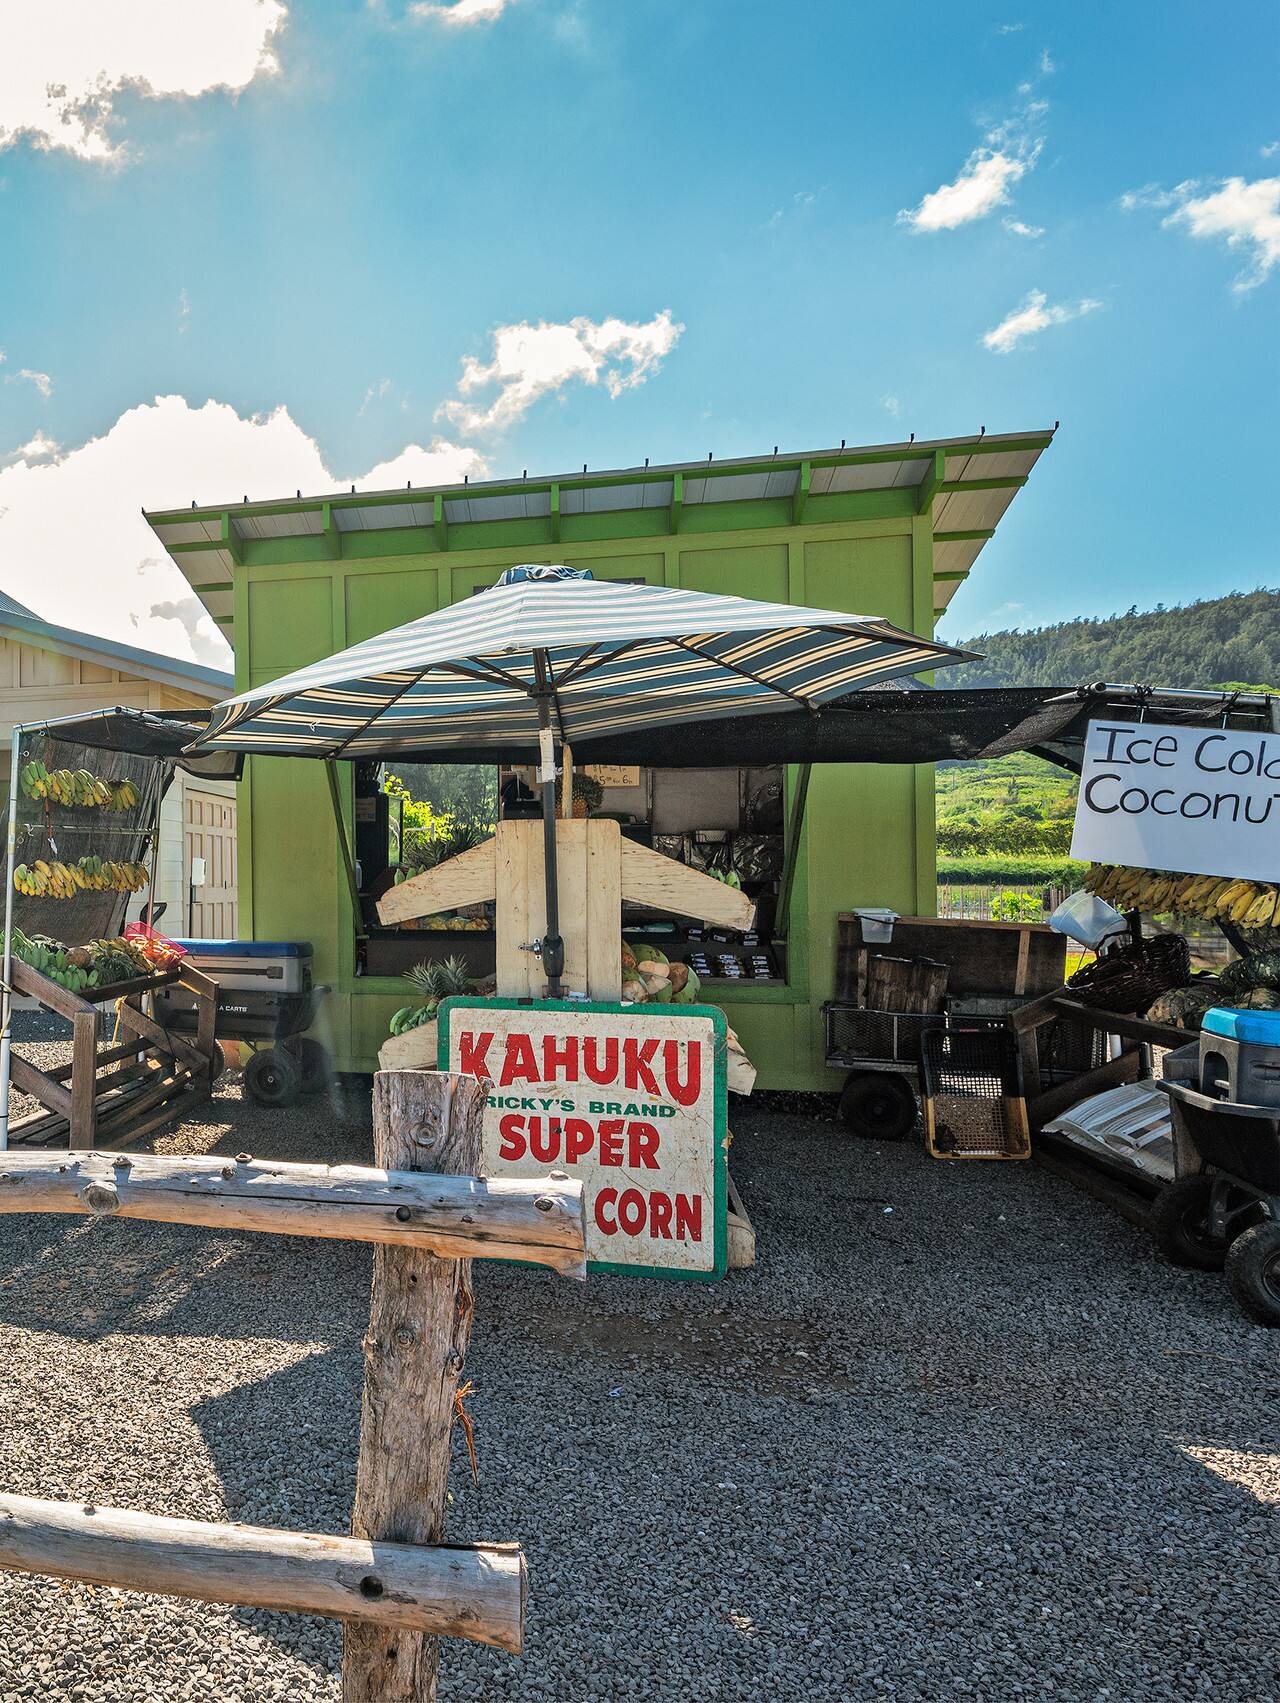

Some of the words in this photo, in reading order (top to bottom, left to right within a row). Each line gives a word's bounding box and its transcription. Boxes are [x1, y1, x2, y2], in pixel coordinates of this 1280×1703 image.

[1093, 726, 1179, 768] Ice
[1084, 773, 1280, 825] Coconu
[458, 1031, 702, 1107] KAHUKU
[589, 1101, 677, 1118] BRAND
[498, 1113, 661, 1170] SUPER
[594, 1187, 702, 1243] CORN
